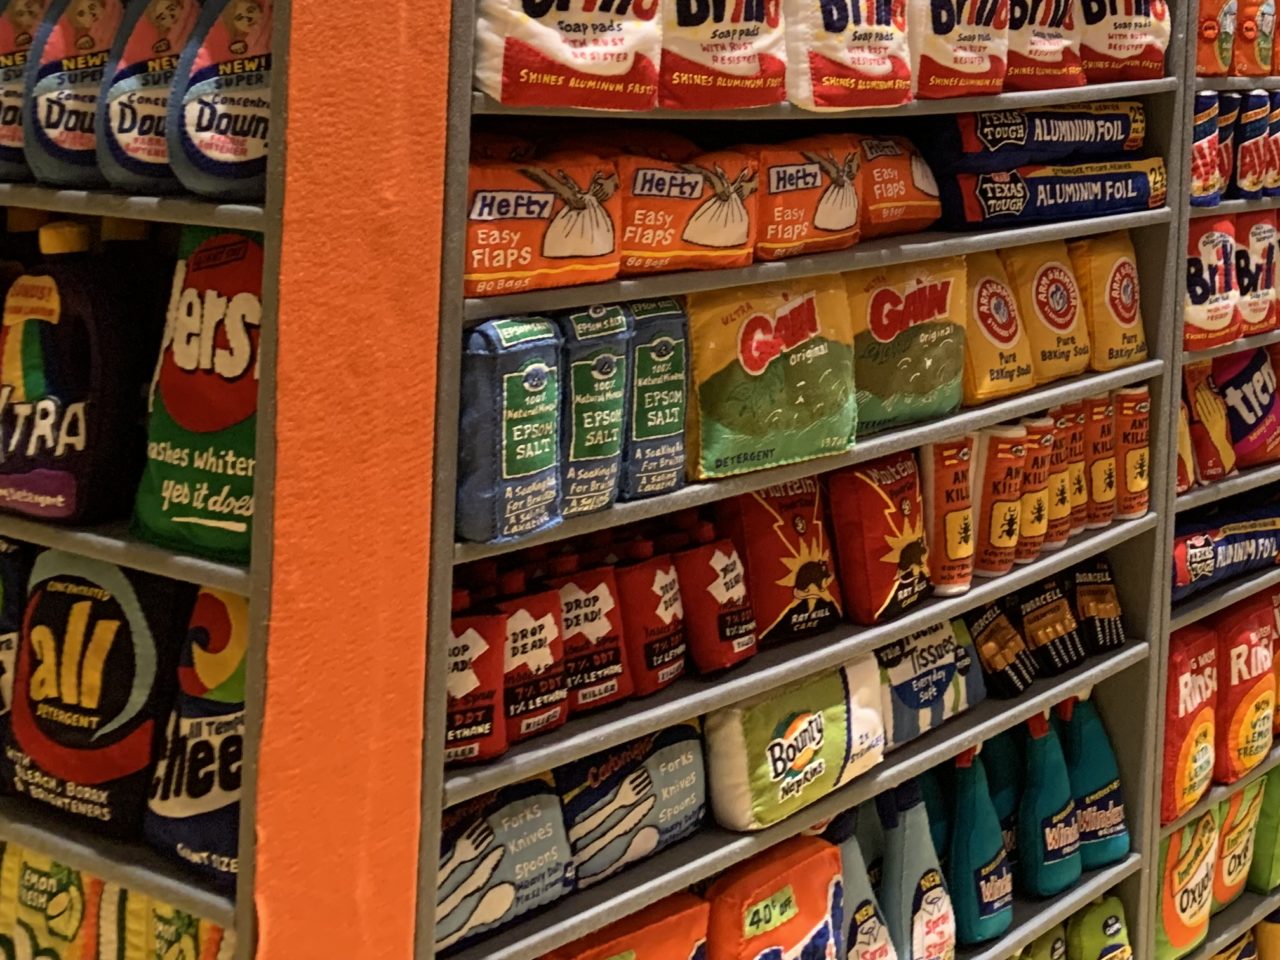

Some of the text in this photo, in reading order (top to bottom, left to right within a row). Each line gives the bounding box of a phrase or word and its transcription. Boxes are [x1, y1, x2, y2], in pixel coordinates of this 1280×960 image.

[558, 20, 623, 36] Soap pads
[217, 57, 266, 75] NEW!
[214, 74, 264, 89] SUPER
[520, 69, 624, 93] SHINES ALUMINUM
[672, 71, 764, 89] SHINES ALUMINUM
[195, 99, 269, 140] Down
[981, 112, 1023, 125] TEXAS
[1129, 106, 1144, 125] 25
[983, 123, 1024, 139] TOUGH
[1034, 118, 1125, 143] ALUMINUM FOIL
[775, 165, 819, 193] Hefty
[872, 167, 898, 184] Easy
[639, 173, 699, 199] Hefty
[873, 181, 906, 199] Flaps
[982, 182, 1024, 197] TEXAS
[1036, 179, 1137, 208] ALUMINUM FOIL
[478, 196, 549, 218] Hefty
[774, 207, 805, 224] Easy
[987, 199, 1023, 212] TOUGH
[633, 209, 673, 229] Easy
[477, 229, 521, 247] Easy
[623, 226, 676, 247] Flaps
[767, 222, 808, 241] Flaps
[472, 248, 532, 269] Flaps
[476, 278, 531, 293] 80 Bags
[721, 302, 753, 326] ULTRA
[919, 326, 954, 343] Original
[1056, 335, 1076, 347] Pure
[790, 342, 829, 366] Original
[1041, 349, 1071, 363] Baking
[644, 391, 682, 409] EPSOM
[583, 409, 622, 429] EPSOM
[647, 407, 680, 427] SALT
[512, 422, 553, 441] EPSOM
[584, 428, 620, 447] SALT
[194, 443, 256, 476] whiter
[516, 439, 551, 460] SALT
[715, 448, 775, 469] DETERGENT
[161, 479, 190, 511] yes
[193, 483, 208, 509] it
[564, 595, 599, 614] DROP
[564, 609, 601, 629] DEAD!
[511, 623, 546, 643] DROP
[30, 600, 121, 709] all
[510, 637, 548, 658] DEAD!
[912, 670, 946, 691] Everyday
[919, 688, 937, 703] Soft
[37, 703, 99, 729] DETERGENT
[768, 711, 825, 781] Bounty
[659, 751, 694, 776] Forks
[661, 773, 697, 801] Knives
[779, 760, 826, 802] Napkins
[66, 781, 109, 804] BORAX
[501, 804, 542, 832] Forks
[508, 823, 554, 855] Knives
